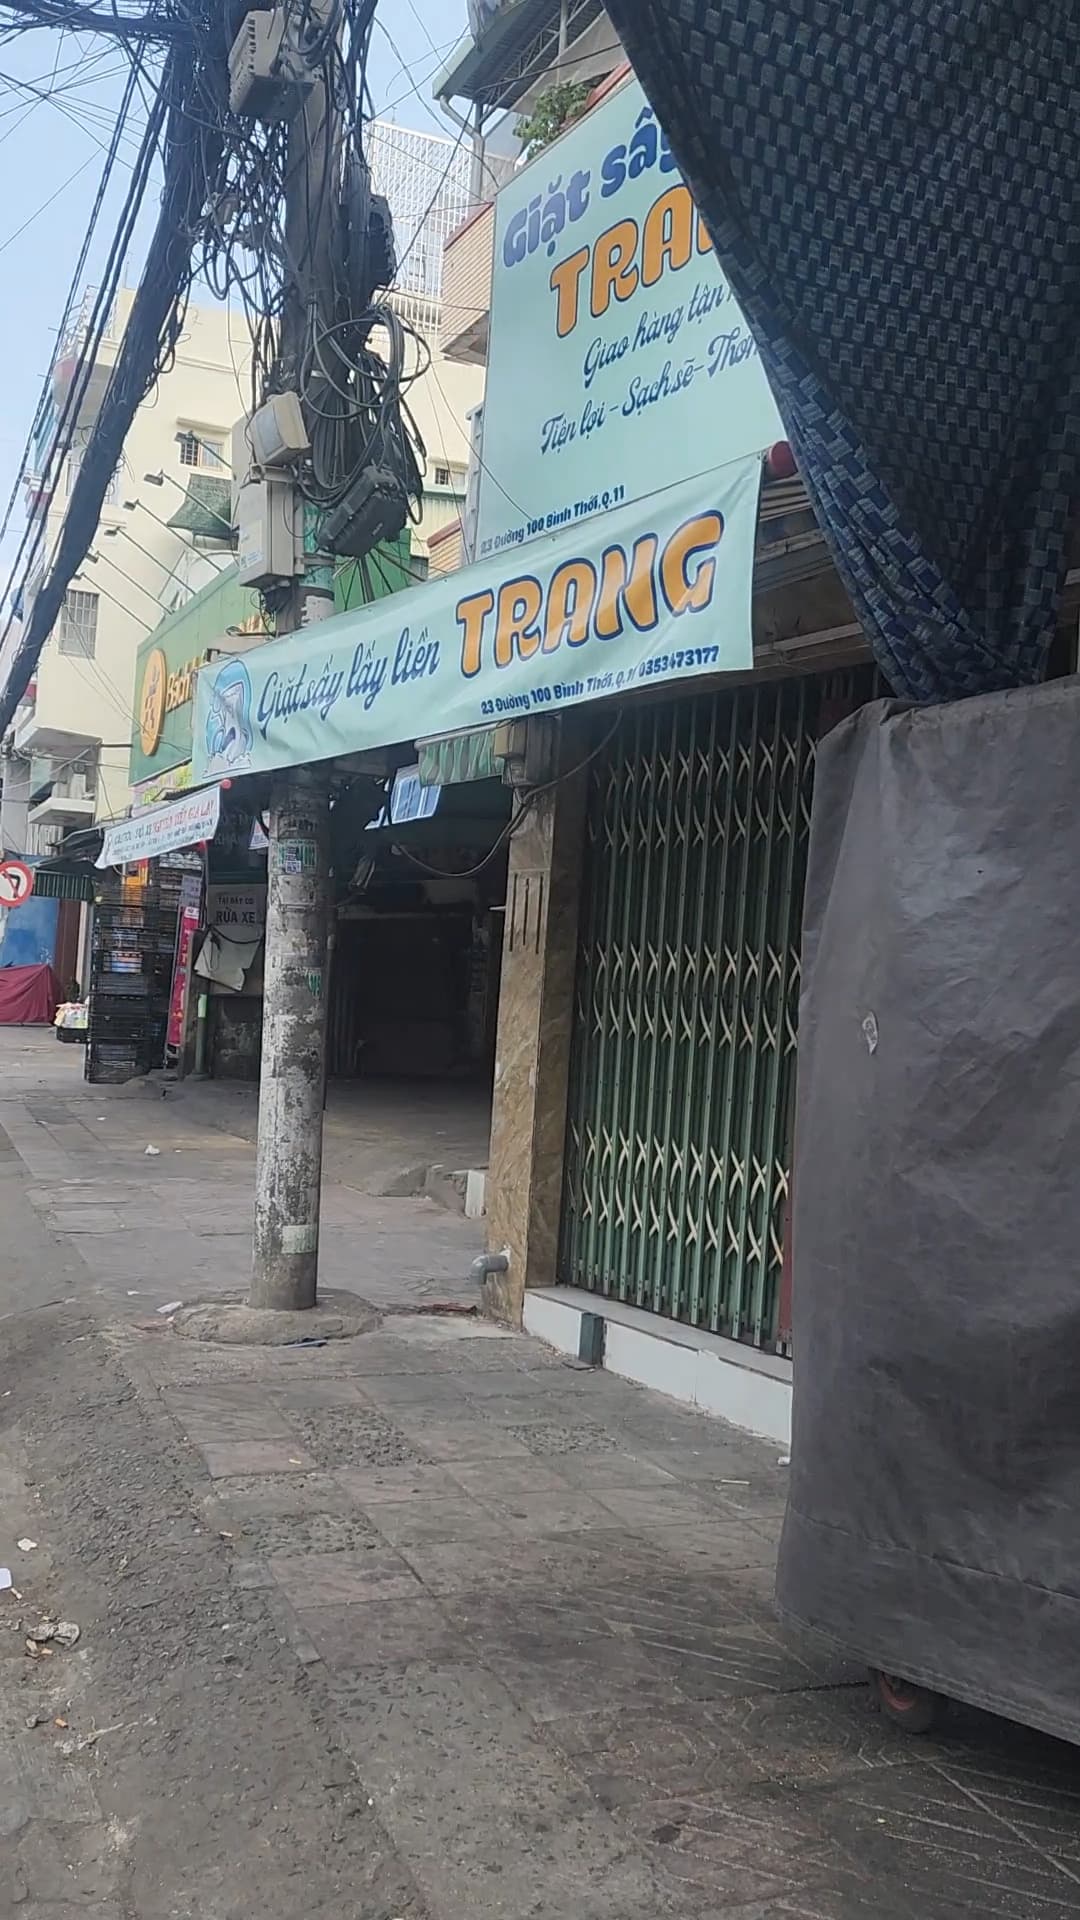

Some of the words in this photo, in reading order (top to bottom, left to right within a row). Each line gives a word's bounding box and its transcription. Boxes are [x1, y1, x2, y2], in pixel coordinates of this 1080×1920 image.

[503, 169, 591, 267] Giặt
[549, 182, 716, 339] TRA
[583, 337, 630, 389] Giao
[632, 311, 684, 344] hàng
[687, 282, 725, 324] tận
[540, 411, 576, 455] Tiện
[579, 399, 607, 441] lợi
[622, 360, 672, 415] Sạch
[493, 525, 524, 550] Đường
[526, 517, 545, 536] 100
[546, 507, 572, 530] Bình
[456, 510, 725, 678] TRANG
[257, 664, 307, 740] Giặt
[305, 654, 345, 721] sấy
[347, 640, 389, 710] lấy
[481, 701, 494, 715] 23
[495, 692, 530, 711] Đường
[531, 686, 551, 704] 100
[553, 681, 583, 699] Bình
[638, 645, 720, 678] 0353473177
[242, 911, 256, 923] XE
